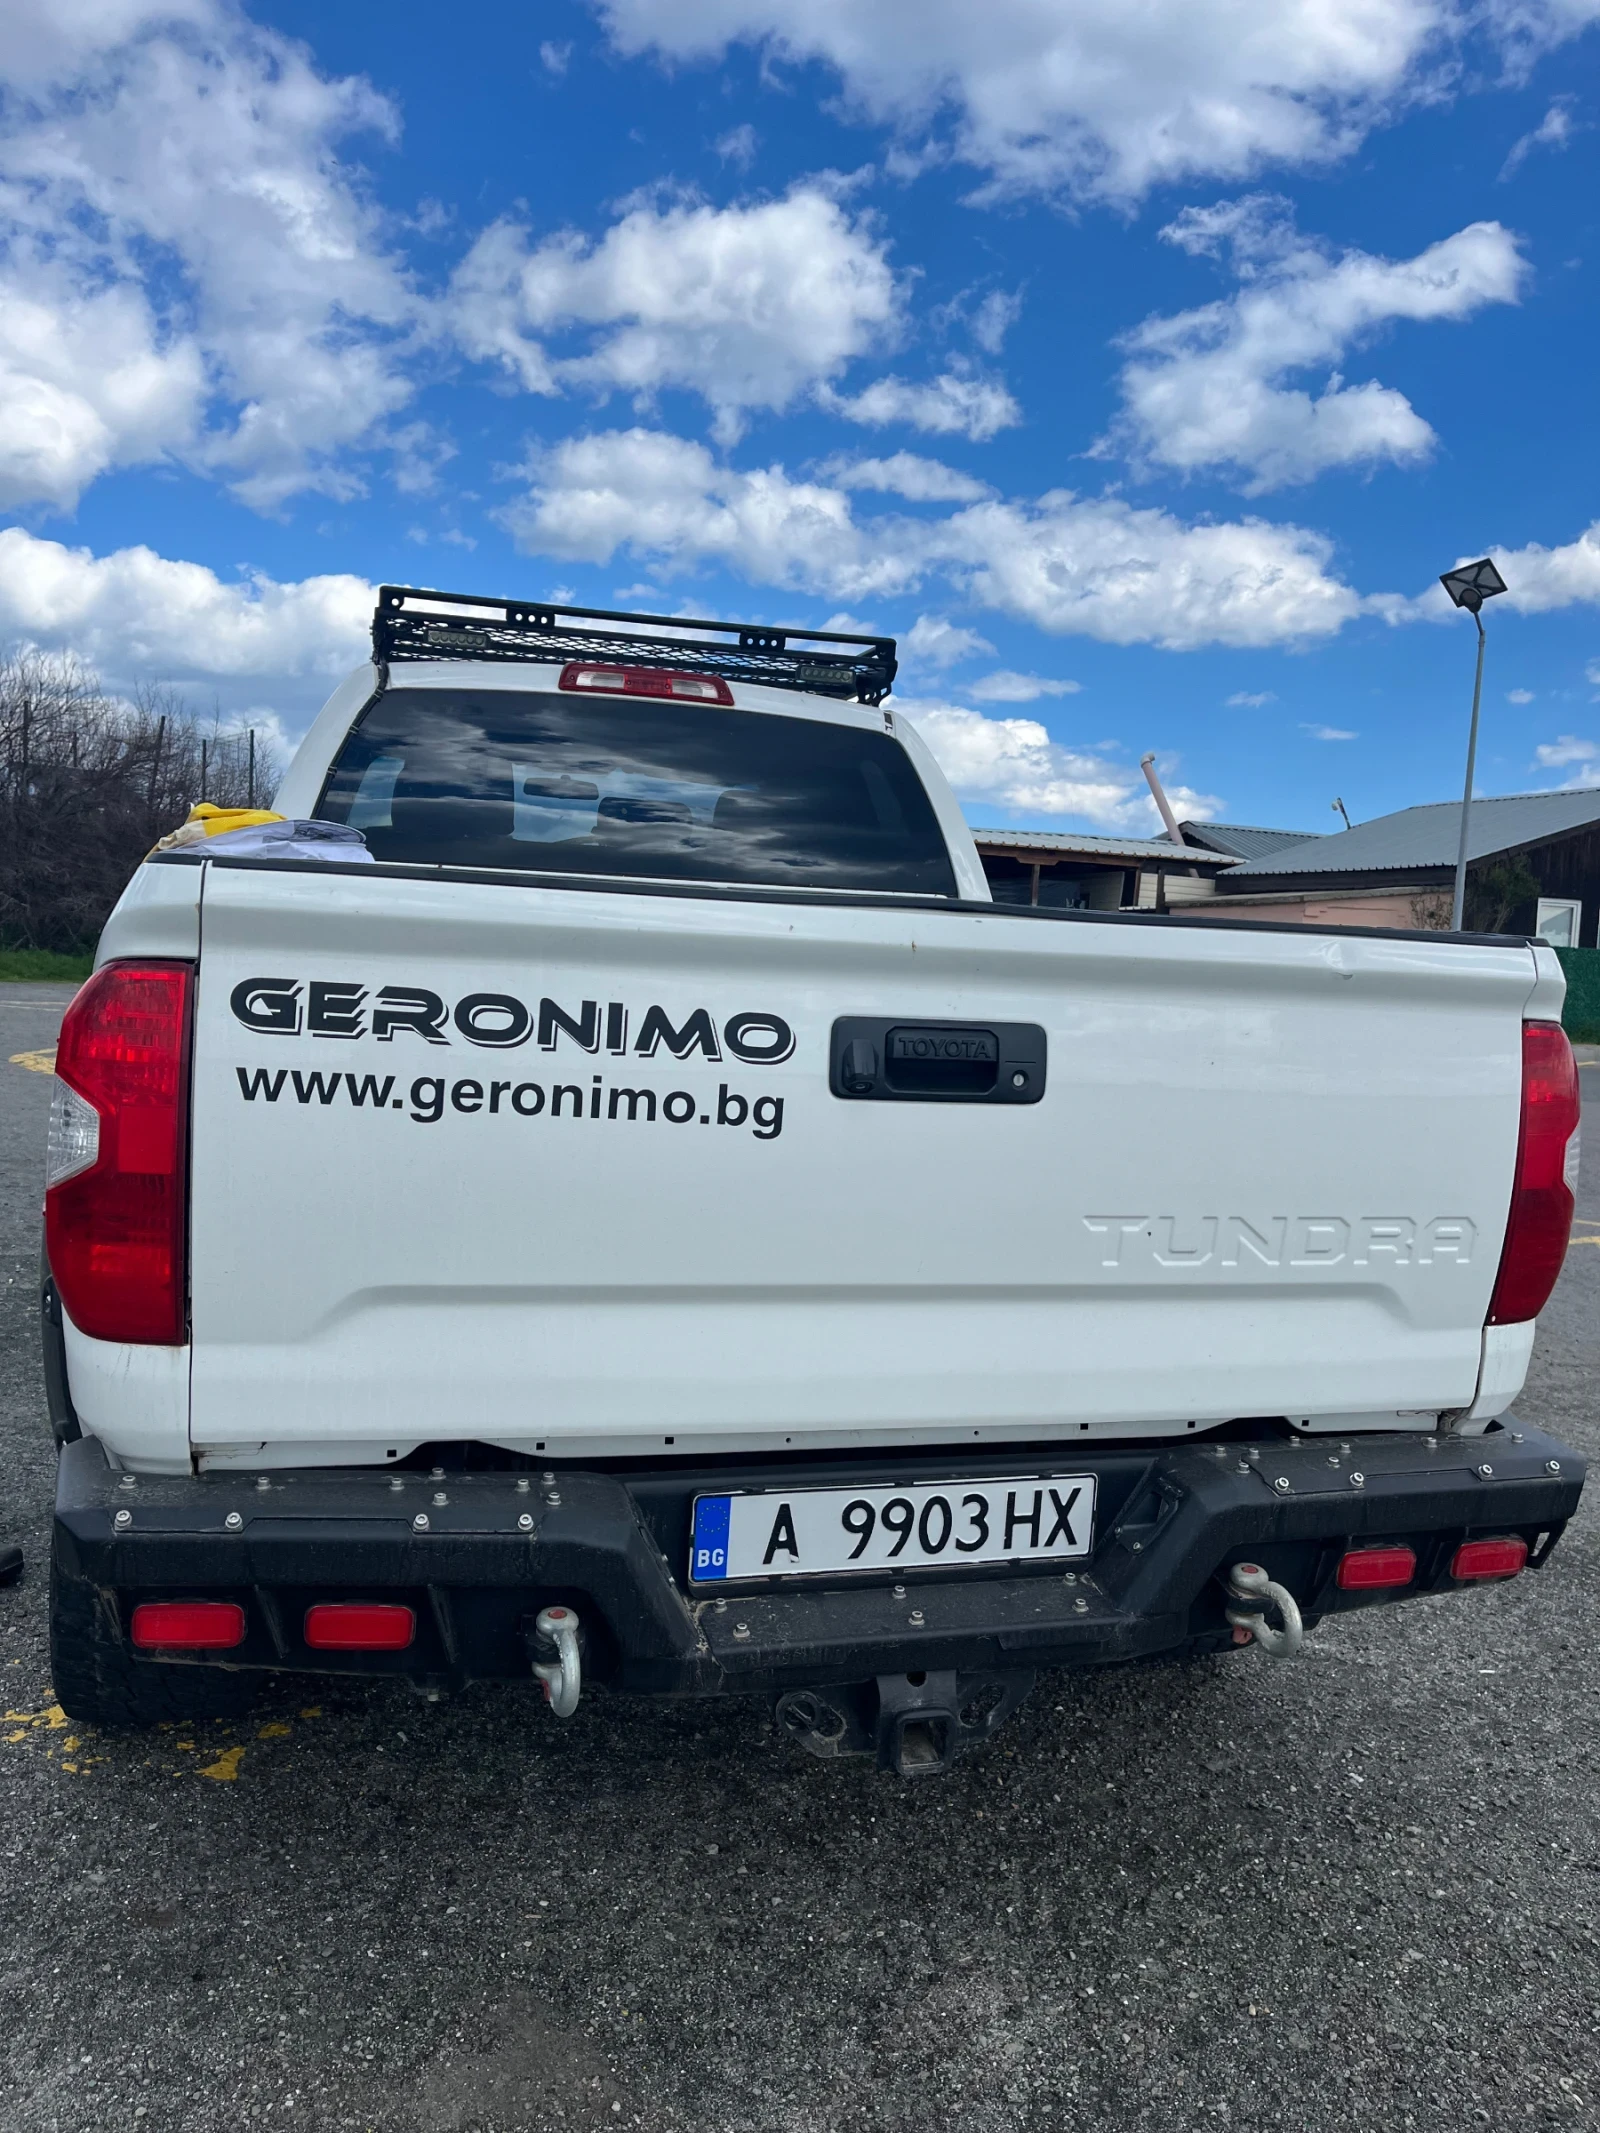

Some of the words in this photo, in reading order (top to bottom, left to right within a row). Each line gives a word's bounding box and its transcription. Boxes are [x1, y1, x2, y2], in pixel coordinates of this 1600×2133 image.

[229, 976, 797, 1066] GERONIMO
[898, 1036, 992, 1060] TOYOTA
[235, 1066, 786, 1140] www.geronimo.bg
[1082, 1214, 1478, 1267] TUNDRA
[697, 1547, 726, 1569] BG
[762, 1502, 800, 1565] A
